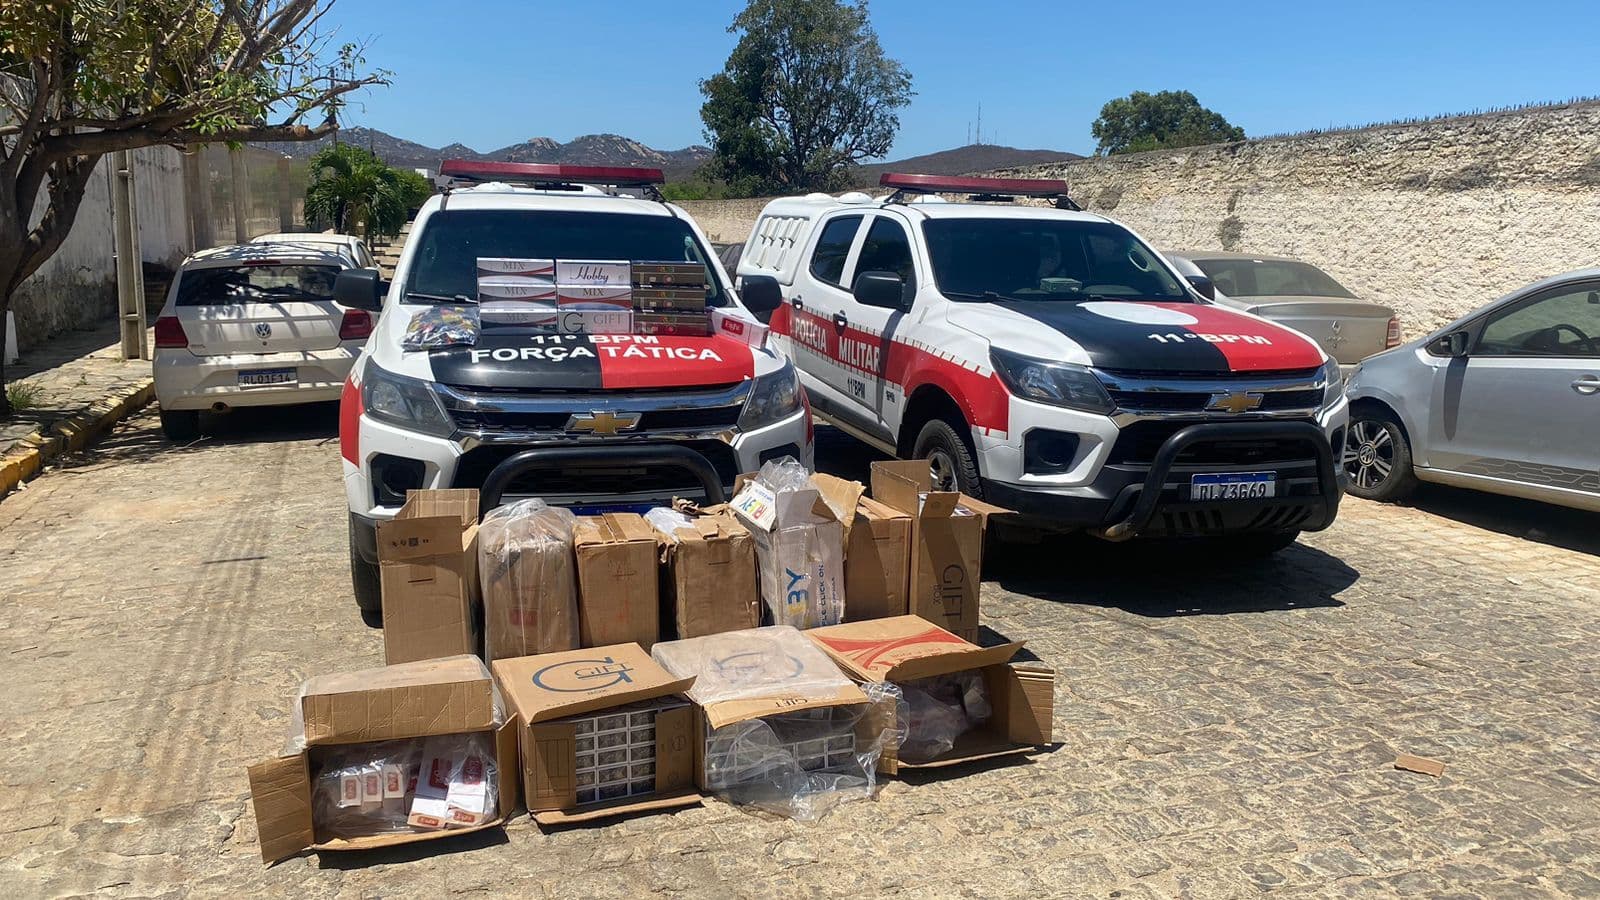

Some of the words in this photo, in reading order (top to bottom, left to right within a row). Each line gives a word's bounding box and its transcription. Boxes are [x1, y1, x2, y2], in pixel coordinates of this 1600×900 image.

[503, 261, 526, 270] MIX
[570, 265, 609, 284] Hobby
[505, 287, 528, 296] MIX
[582, 288, 605, 296] MIX
[506, 312, 529, 321] MIX
[564, 312, 585, 333] G
[593, 313, 623, 325] GIFT
[589, 334, 660, 344] BPM
[795, 317, 827, 353] POLÍCIA
[839, 336, 880, 372] MILITAR
[470, 346, 596, 364] FORÇA
[600, 344, 723, 362] TÁTICA
[942, 564, 964, 621] GIFT
[574, 662, 633, 677] GIFT
